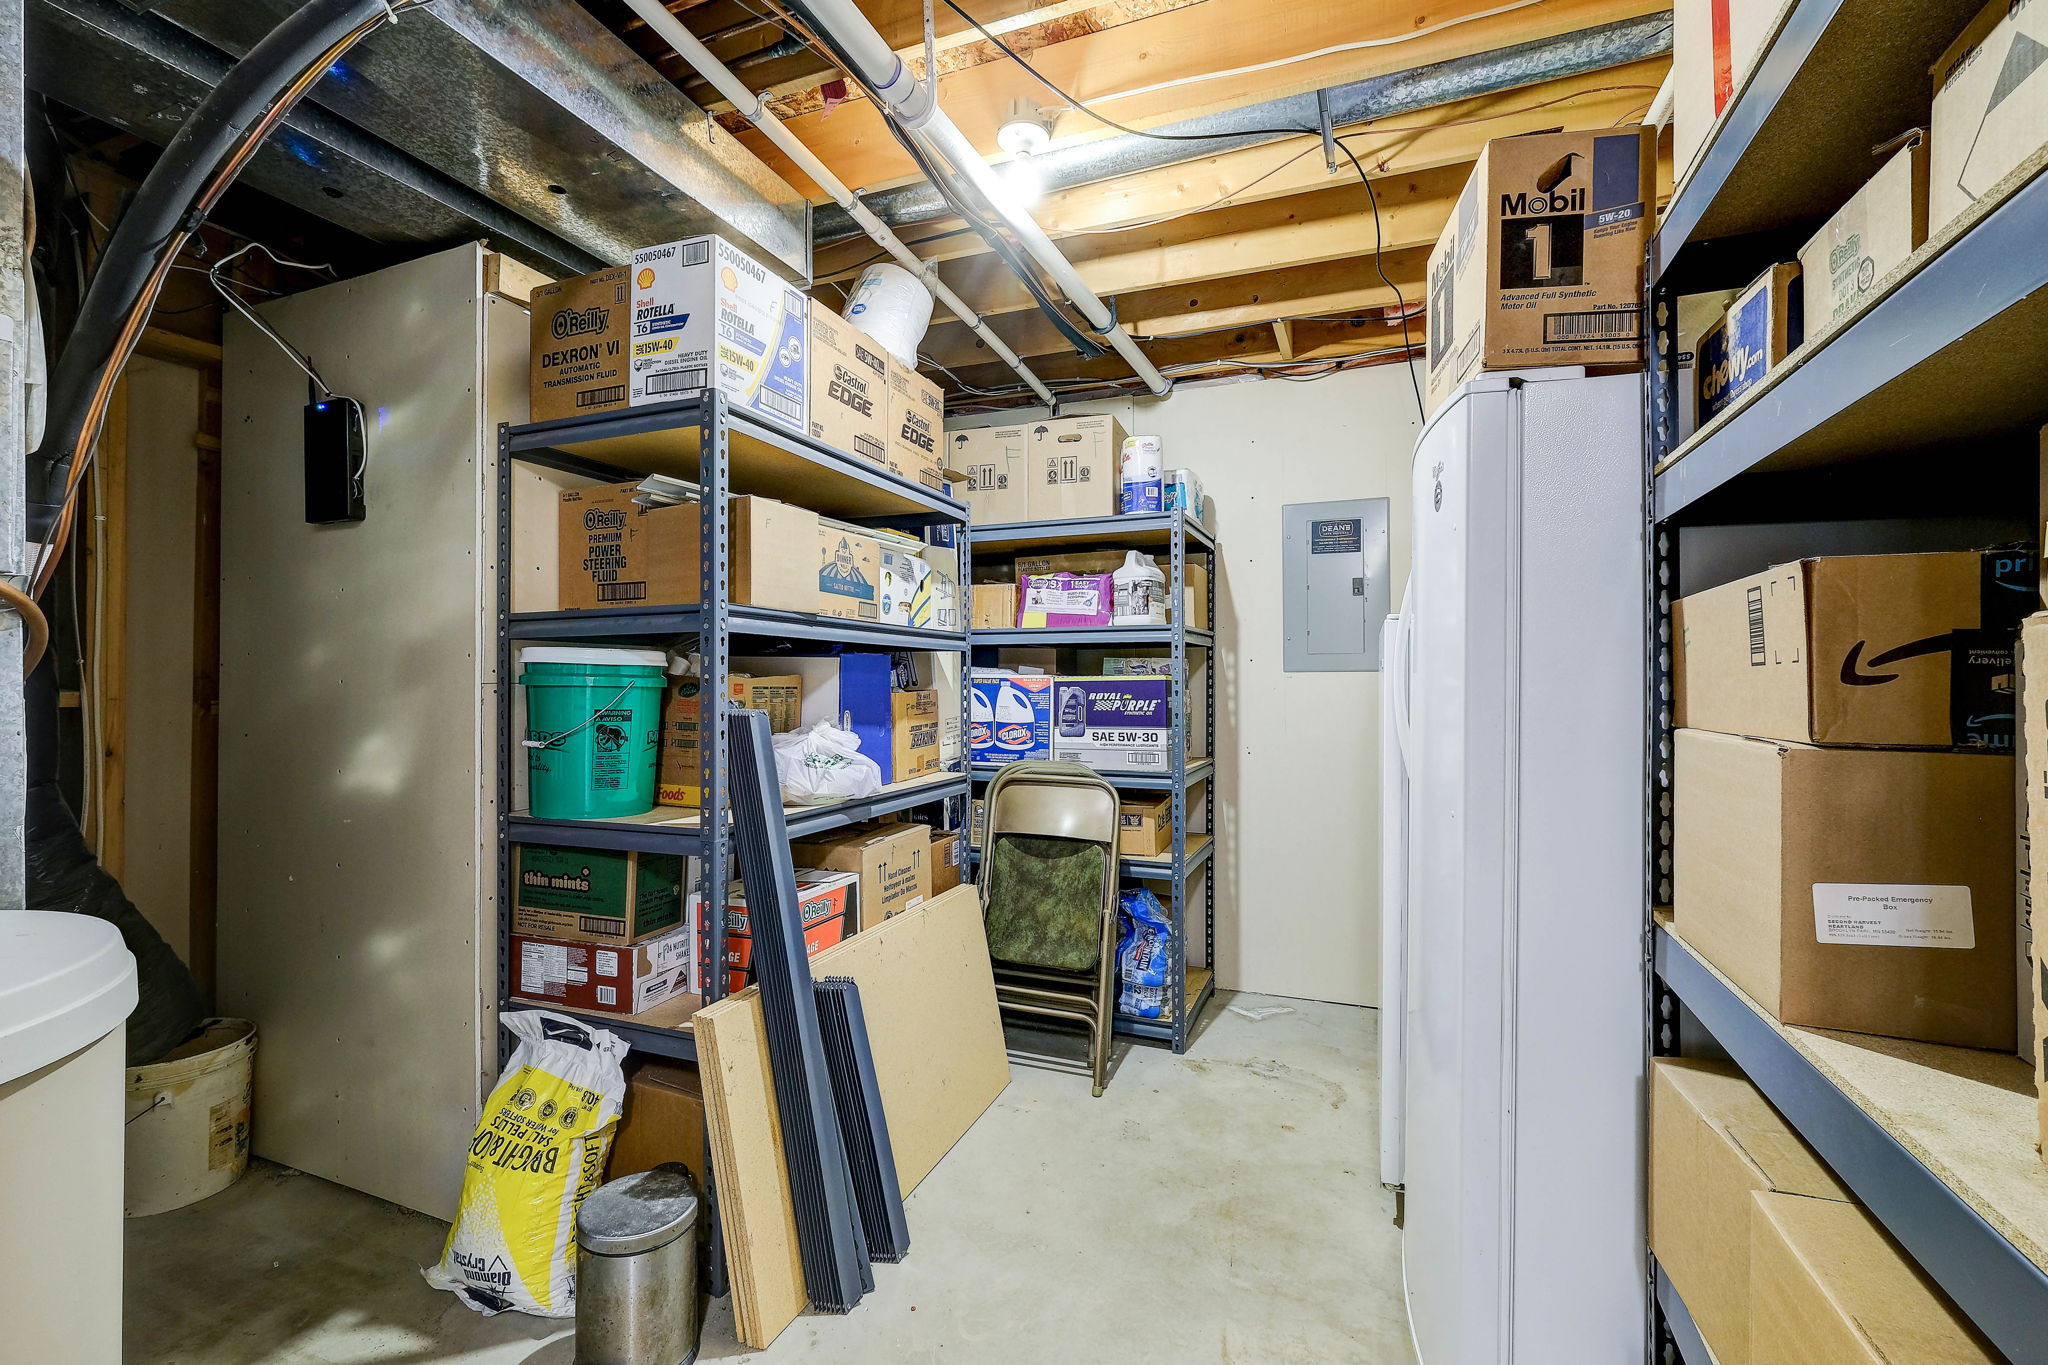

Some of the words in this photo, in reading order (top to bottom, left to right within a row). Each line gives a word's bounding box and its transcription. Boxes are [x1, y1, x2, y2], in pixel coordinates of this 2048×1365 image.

[1944, 62, 1967, 94] Aerosol
[1968, 46, 1983, 68] Cans
[1501, 188, 1586, 216] Mobil
[1598, 208, 1631, 224] 5W-20
[634, 246, 676, 264] 550050467
[1526, 222, 1552, 280] 1
[718, 242, 766, 284] 550050467
[1432, 234, 1455, 297] Mobil
[544, 286, 562, 296] GALLON
[1500, 292, 1540, 302] Advanced
[1542, 291, 1556, 299] Full
[1558, 290, 1597, 300] Synthetic
[636, 296, 654, 309] Shell
[720, 297, 738, 313] Shell
[1500, 302, 1524, 310] Motor
[636, 303, 674, 321] ROTELLA
[552, 306, 610, 340] O'Reilly
[636, 324, 648, 334] T6
[721, 307, 755, 335] ROTELLA
[721, 323, 733, 339] T6
[542, 343, 599, 368] DEXRON
[606, 340, 620, 356] VI
[645, 339, 673, 353] 15W-40
[678, 350, 693, 358] HEAVY
[559, 361, 600, 376] AUTOMATIC
[728, 350, 754, 372] 15W-40
[544, 373, 595, 388] TRANSMISSION
[596, 369, 618, 380] FLUID
[842, 370, 867, 395] Castrol
[828, 380, 874, 418] EDGE
[912, 414, 930, 434] Castrol
[901, 423, 935, 454] EDGE
[583, 508, 628, 530] O'Reilly
[588, 532, 622, 544] PREMIUM
[588, 544, 622, 558] POWER
[583, 556, 627, 571] STEERING
[592, 569, 618, 582] FLUID
[1968, 655, 2012, 666] elivery
[1112, 699, 1158, 711] PURPLE
[970, 726, 986, 738] OROX
[1001, 728, 1027, 740] CLOROX
[1092, 732, 1115, 742] SAE
[1118, 732, 1158, 742] 5W-30
[524, 871, 549, 887] thin
[551, 874, 589, 891] mints
[888, 870, 897, 880] Hand
[898, 866, 912, 876] Cleaner
[884, 880, 902, 892] Nettoyeur
[905, 874, 916, 883] mains
[882, 891, 900, 904] Limpiador
[900, 888, 906, 896] De
[906, 883, 918, 893] Manos
[1891, 896, 1934, 904] Emergency
[802, 899, 832, 923] O'Reilly
[728, 912, 748, 932] eilly
[581, 1090, 600, 1107] 40LB
[550, 1129, 560, 1137] for
[452, 1250, 486, 1272] Crystal
[464, 1269, 512, 1286] Diamond
